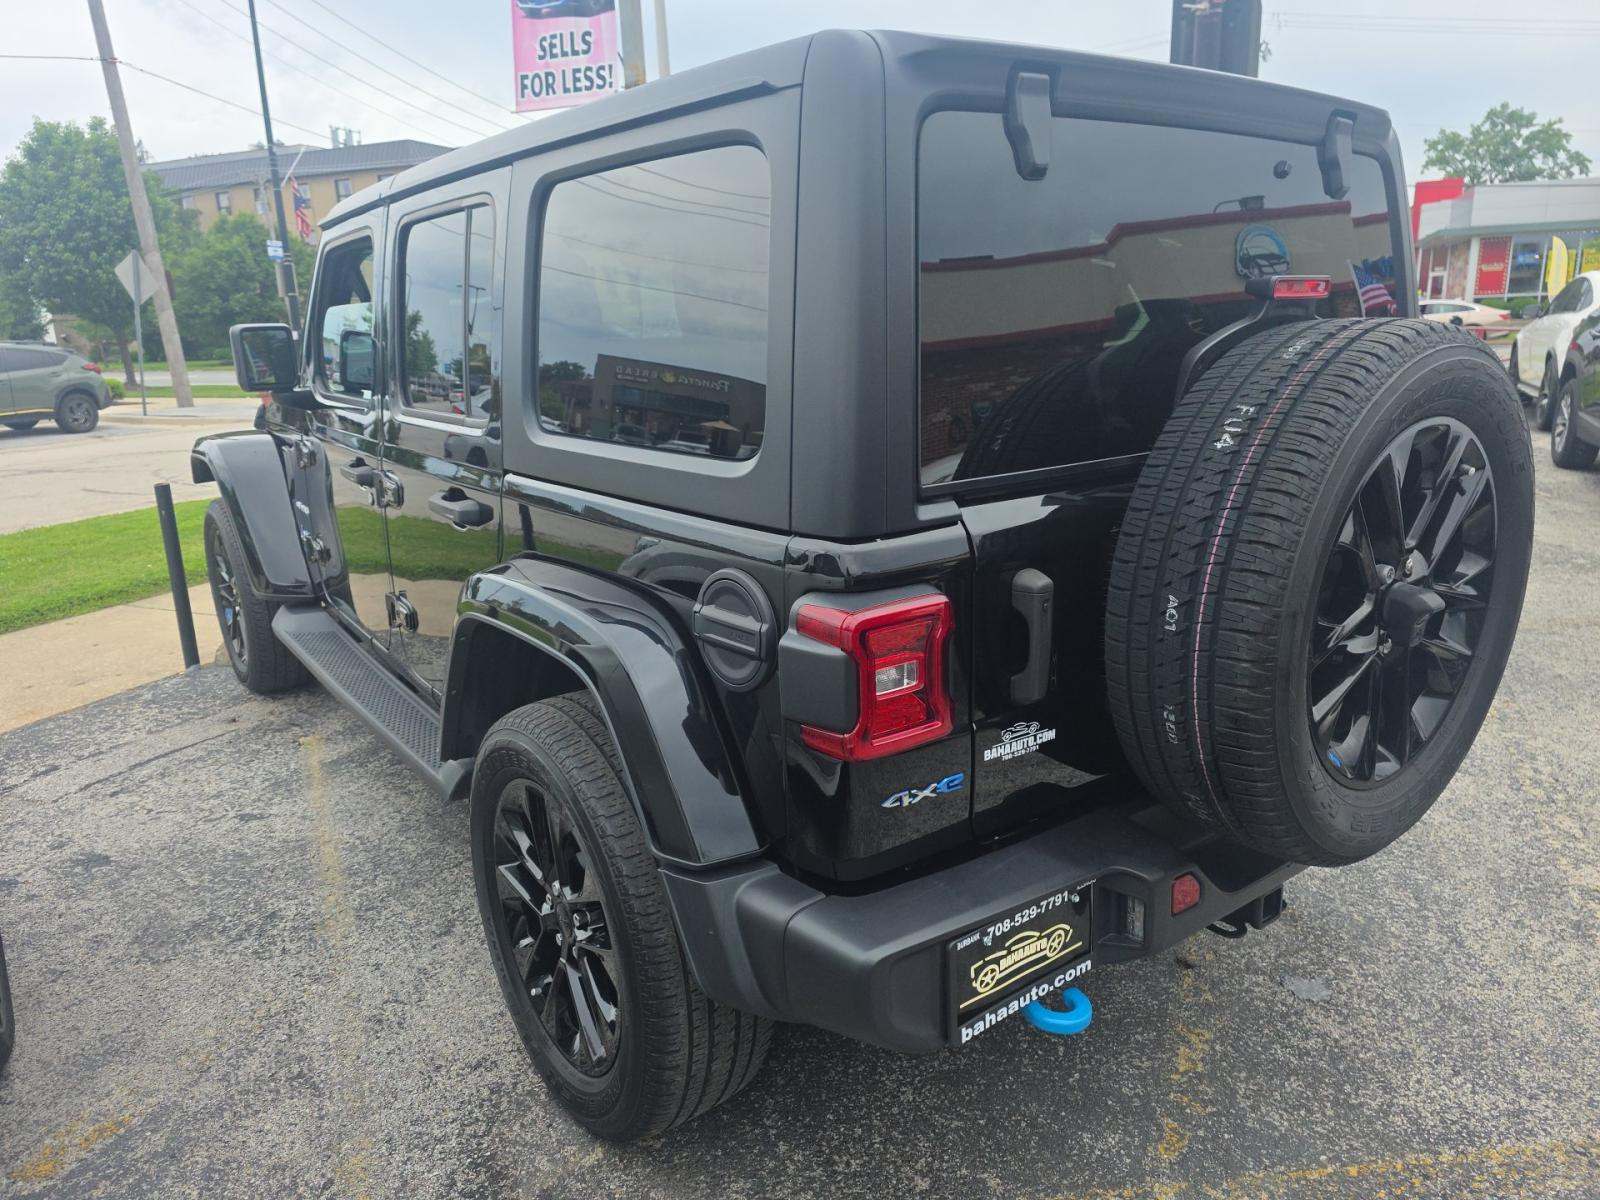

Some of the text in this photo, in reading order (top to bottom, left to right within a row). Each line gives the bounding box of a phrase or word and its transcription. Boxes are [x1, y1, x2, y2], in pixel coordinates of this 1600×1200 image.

[537, 30, 593, 61] SELLS
[520, 64, 614, 99] FOR LESS!
[984, 729, 1056, 762] BAHAAUTO.COM
[986, 890, 1069, 938] 708-529-7791
[961, 959, 1092, 1044] bahaauto.com
